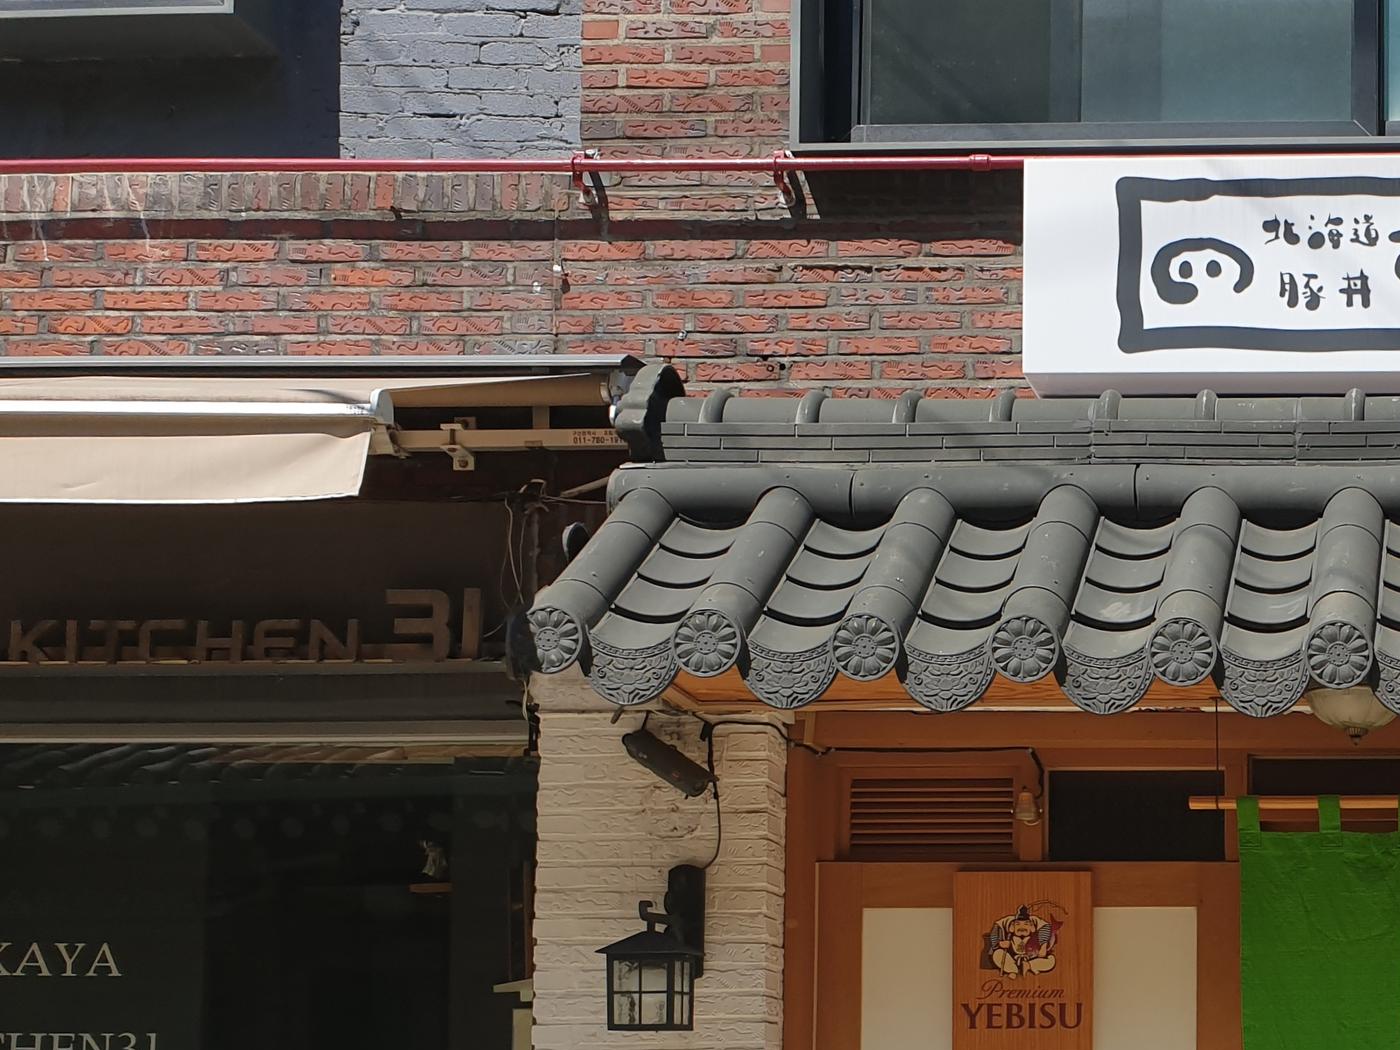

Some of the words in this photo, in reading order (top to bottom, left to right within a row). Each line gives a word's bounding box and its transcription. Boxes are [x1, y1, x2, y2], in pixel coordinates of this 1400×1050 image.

[1262, 212, 1379, 250] 北海道
[8, 618, 360, 663] KITCHEN
[385, 587, 484, 663] 31
[976, 979, 1065, 1000] Premium
[960, 1002, 1083, 1030] YEBISU
